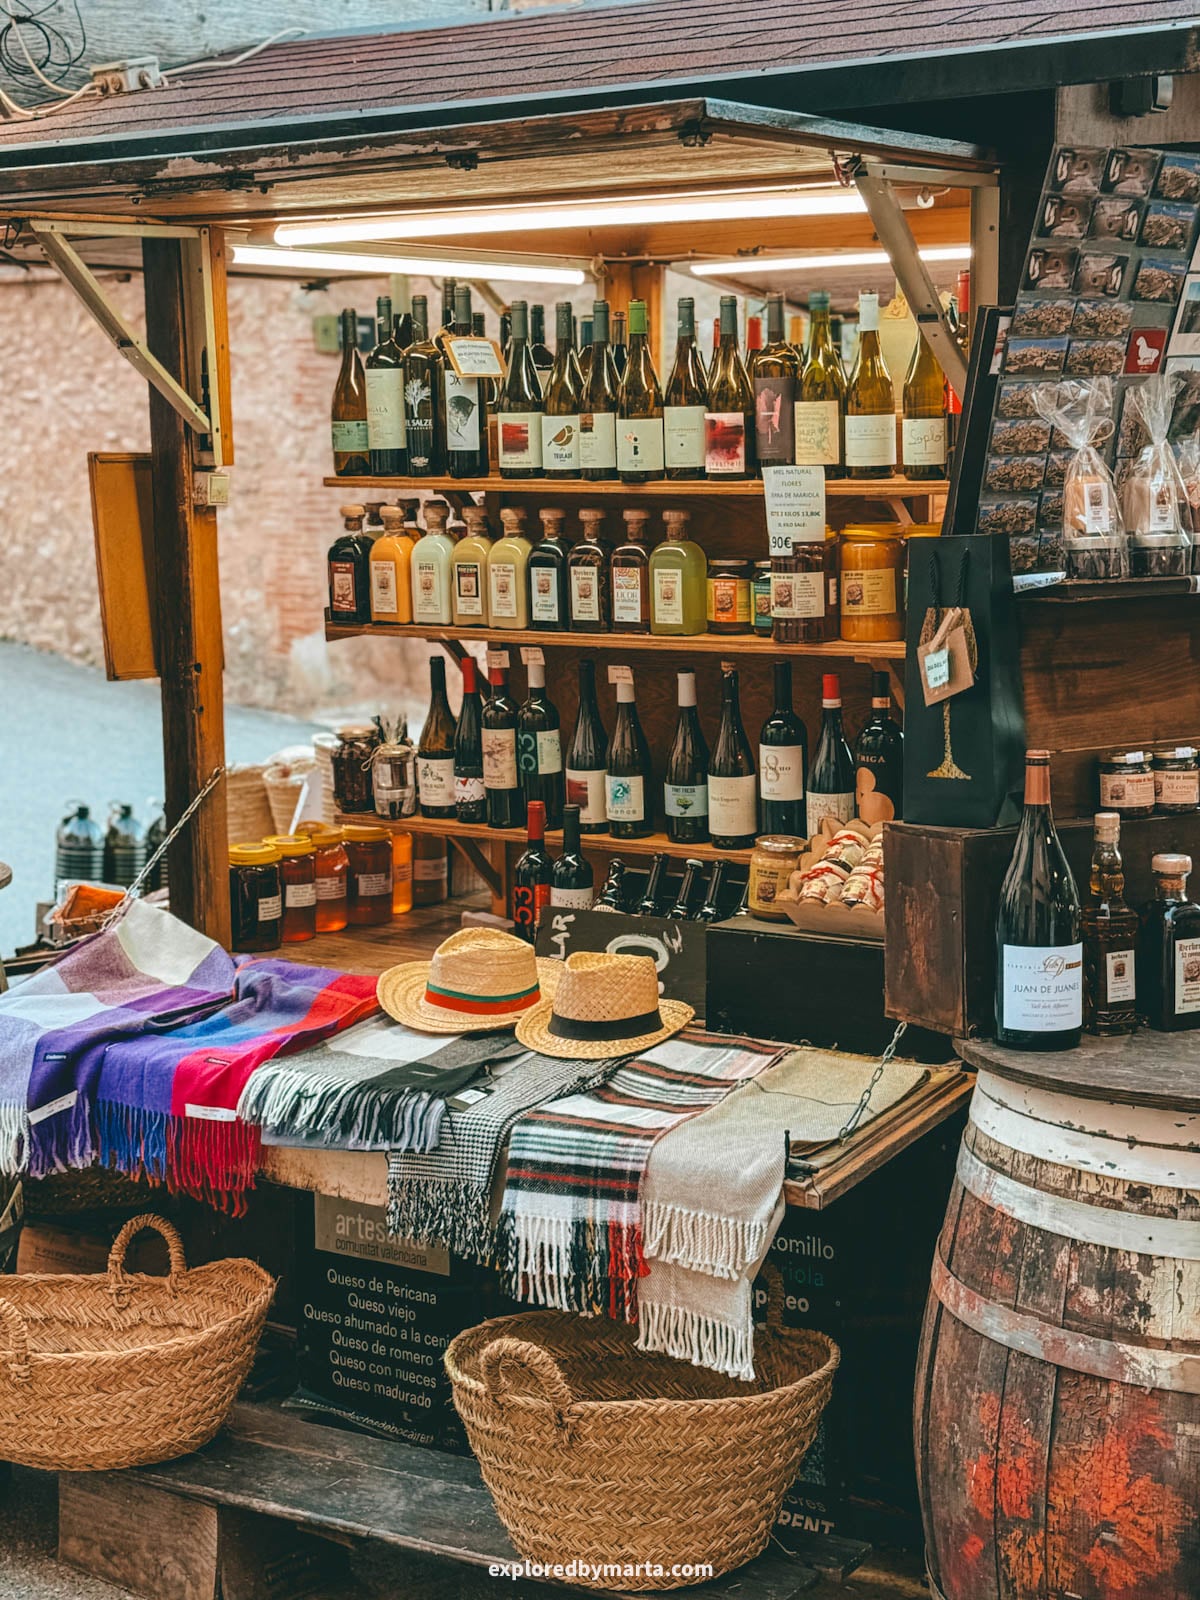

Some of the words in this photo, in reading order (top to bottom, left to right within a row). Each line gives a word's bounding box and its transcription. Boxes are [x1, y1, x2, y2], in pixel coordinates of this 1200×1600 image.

[771, 536, 792, 549] 90€
[513, 886, 533, 925] 53
[1013, 984, 1037, 993] JUAN
[1040, 985, 1051, 994] DE
[1054, 982, 1080, 994] JUANES
[335, 1237, 380, 1257] comunitat
[380, 1245, 428, 1266] valenciana
[326, 1268, 366, 1289] Queso
[368, 1276, 384, 1293] de
[386, 1279, 438, 1305] Pericana
[303, 1303, 342, 1325] Queso
[344, 1312, 398, 1339] ahumado
[400, 1327, 408, 1340] a
[410, 1326, 422, 1343] la
[347, 1292, 385, 1314] Queso
[388, 1301, 417, 1323] viejo
[331, 1329, 370, 1352] Queso
[371, 1338, 387, 1356] de
[389, 1347, 434, 1367] romero
[329, 1350, 366, 1373] Queso
[369, 1362, 392, 1376] con
[395, 1367, 437, 1388] nueces
[331, 1370, 371, 1393] Queso
[374, 1380, 432, 1409] madurado
[783, 1494, 826, 1513] ores
